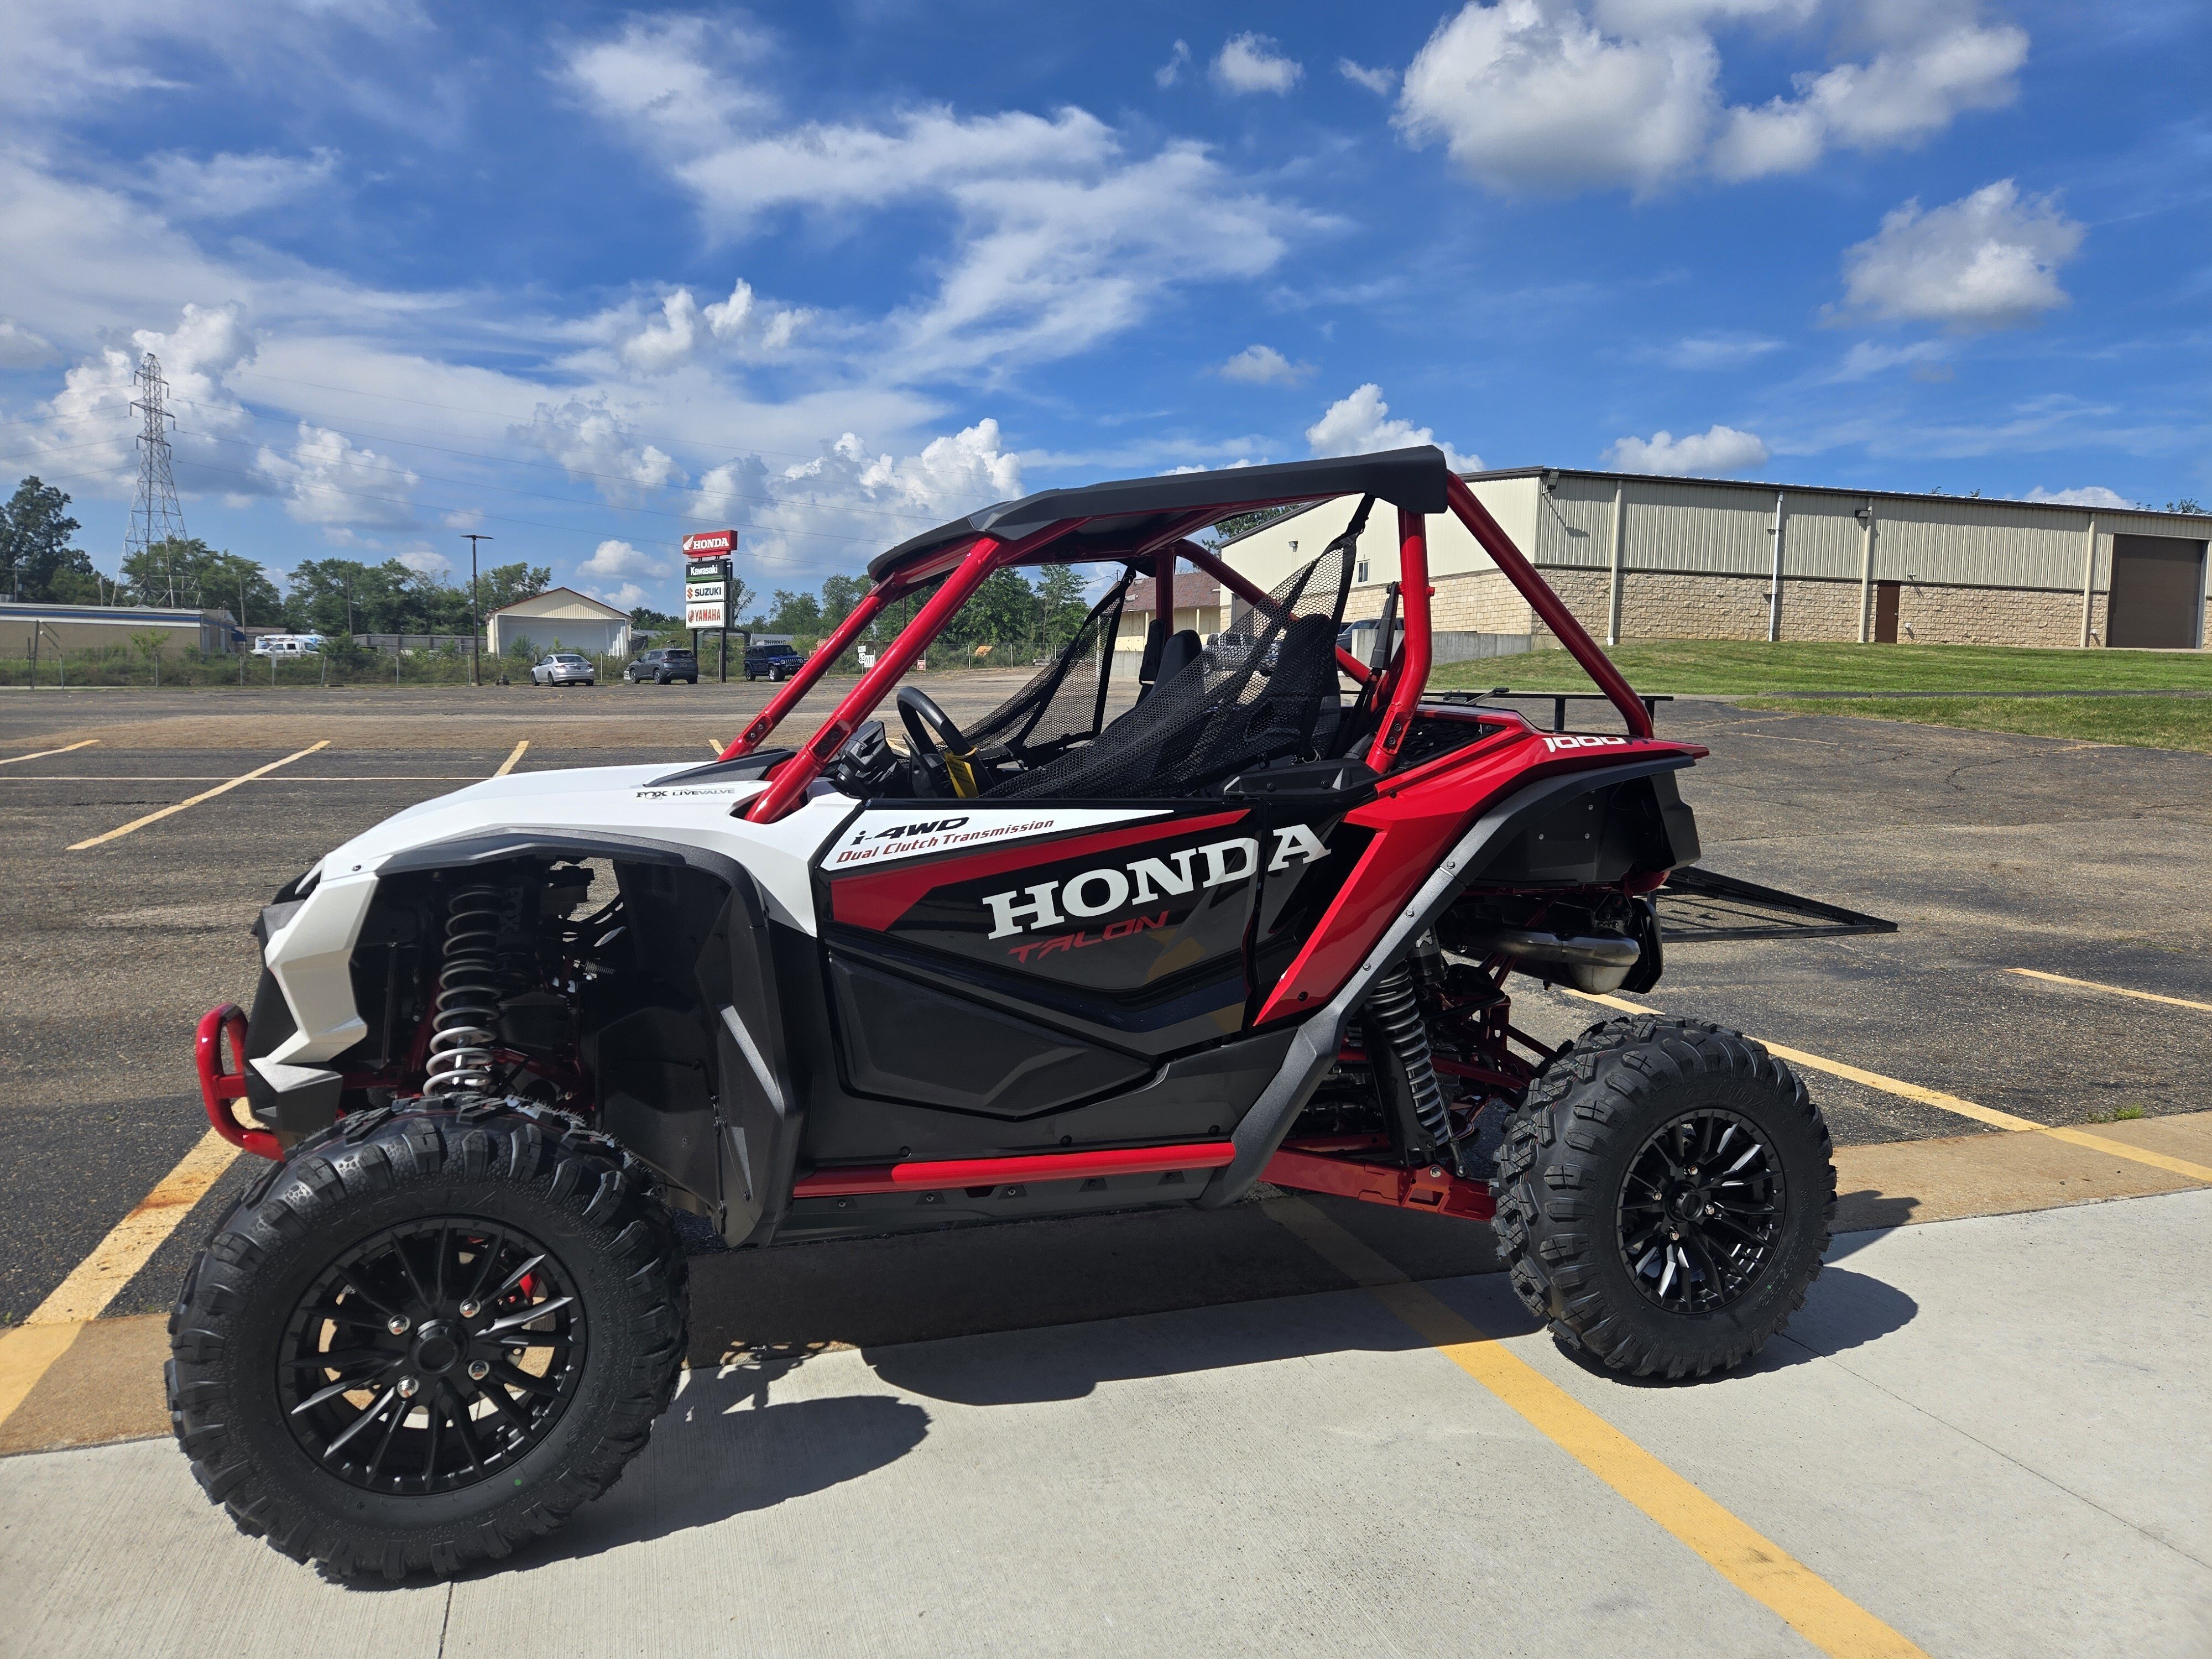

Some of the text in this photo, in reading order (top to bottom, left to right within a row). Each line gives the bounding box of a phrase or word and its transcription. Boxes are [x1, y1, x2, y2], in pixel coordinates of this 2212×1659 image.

[693, 537, 729, 550] HONDA
[690, 565, 718, 576] Kawasaki
[695, 587, 722, 597] SUZUKI
[695, 608, 721, 622] YAMAHA
[636, 791, 668, 800] FOX
[850, 817, 969, 846] i-4WD
[836, 820, 1055, 863] Dual Clutch Transmission
[982, 824, 1332, 940] HONDA
[1008, 910, 1169, 964] TALON
